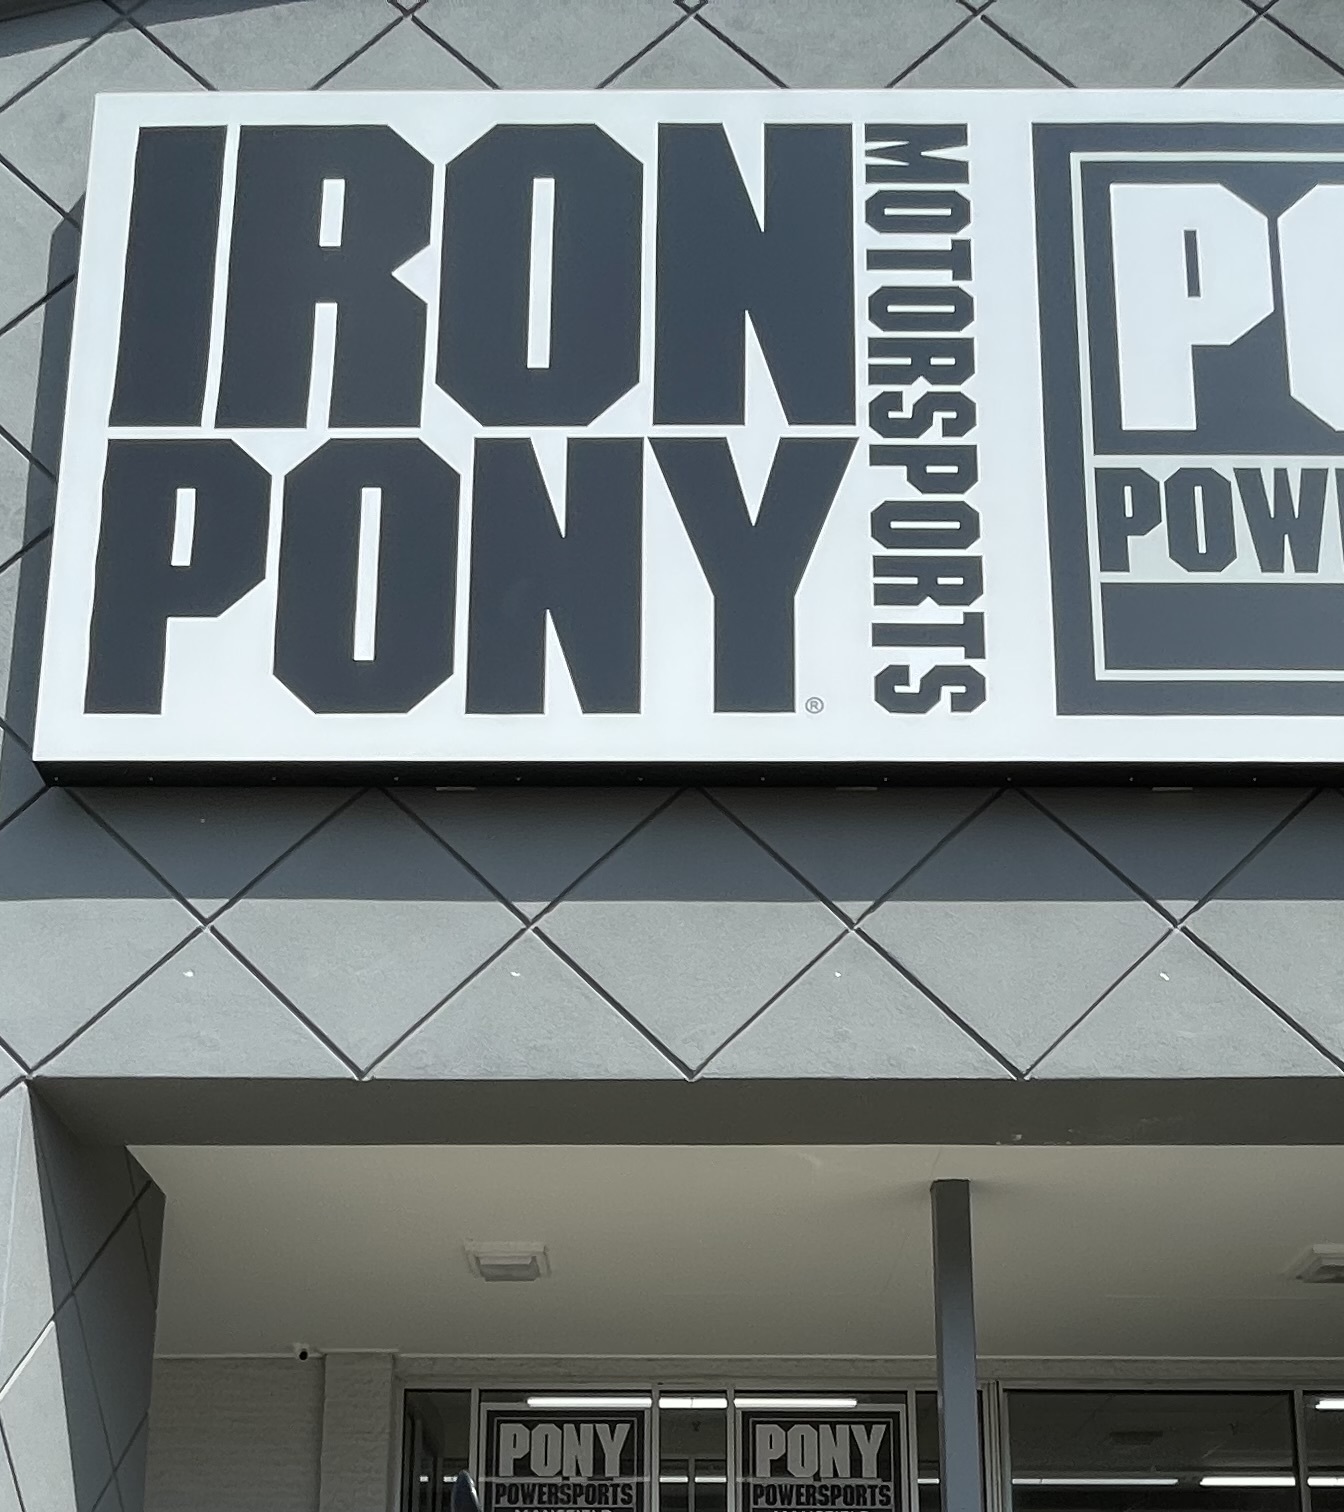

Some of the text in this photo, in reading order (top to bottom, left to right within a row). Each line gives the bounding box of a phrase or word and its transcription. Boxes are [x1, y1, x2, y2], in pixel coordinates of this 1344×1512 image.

[108, 122, 856, 428] IRON
[864, 122, 986, 714] MOTORSPORTS
[84, 437, 860, 714] PONY
[498, 1423, 631, 1477] PONY
[755, 1424, 887, 1478] PONY
[495, 1482, 633, 1505] POWERSPORTS
[753, 1483, 892, 1506] POWERSPORTS
